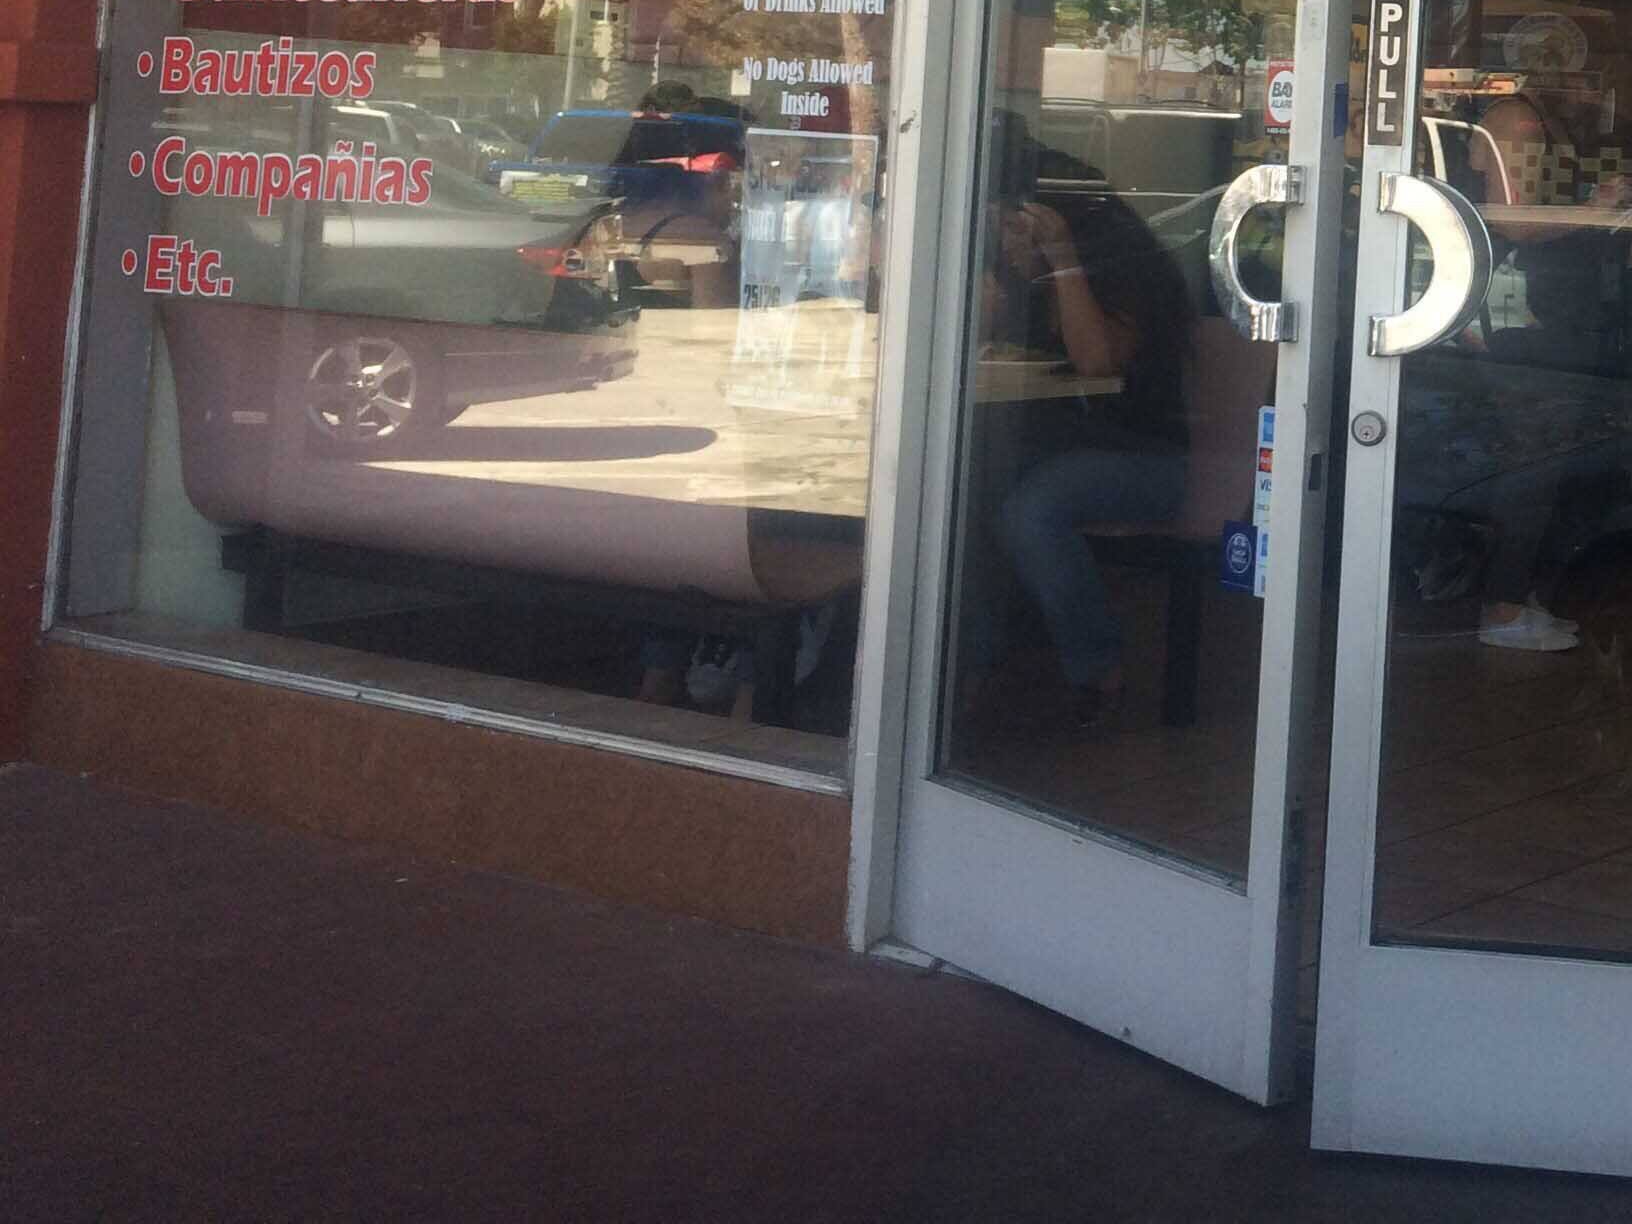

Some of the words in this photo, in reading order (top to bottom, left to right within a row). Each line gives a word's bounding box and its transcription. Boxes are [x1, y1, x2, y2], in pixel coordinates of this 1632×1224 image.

[158, 34, 377, 100] Bautizos
[743, 56, 763, 81] No
[766, 56, 805, 85] Dogs
[808, 58, 873, 85] Allowed
[1376, 3, 1403, 133] PULL
[780, 90, 830, 117] Inside
[143, 232, 235, 297] Etc.
